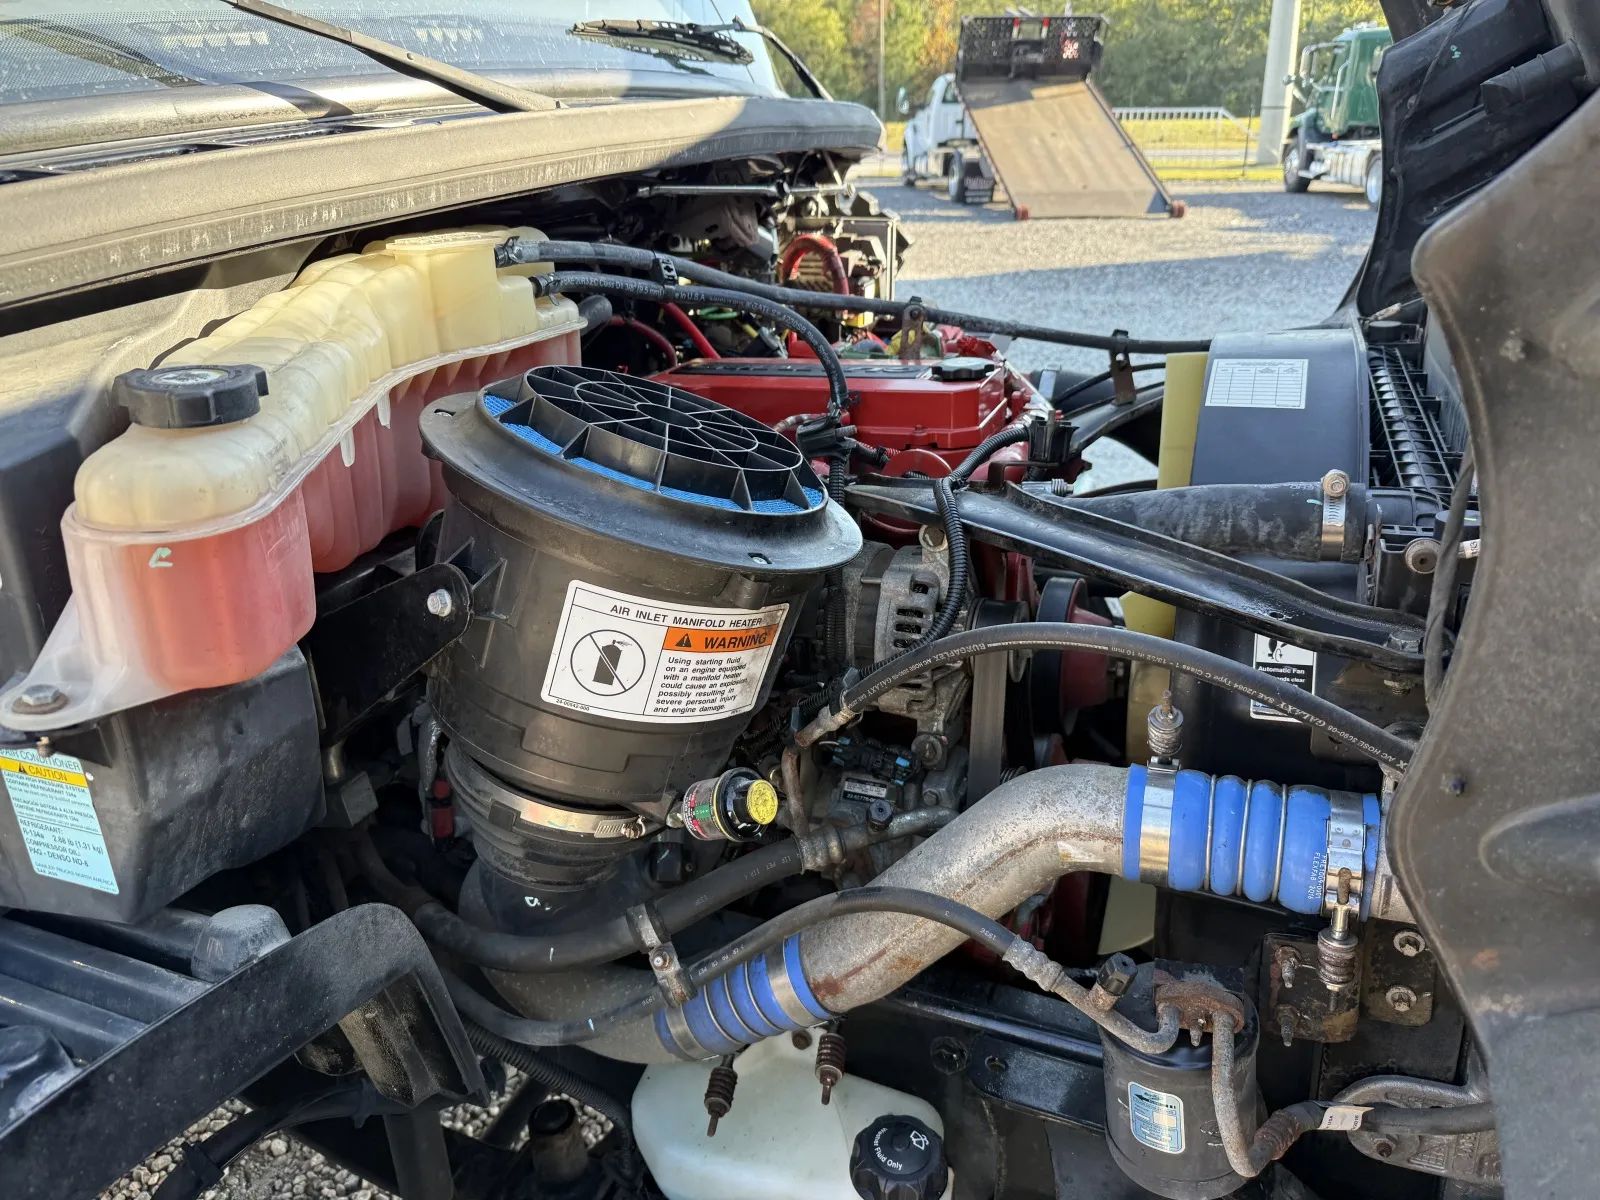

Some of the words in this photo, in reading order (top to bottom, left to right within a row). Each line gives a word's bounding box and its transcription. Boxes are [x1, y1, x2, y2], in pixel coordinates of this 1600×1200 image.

[610, 604, 630, 616] AIR
[635, 610, 668, 623] INLET
[672, 616, 726, 628] MANIFOLD
[729, 617, 762, 628] HEATER
[704, 632, 768, 649] WARNING
[668, 656, 691, 666] Using
[695, 657, 723, 666] starting
[726, 656, 741, 664] fluid
[665, 665, 676, 673] on
[691, 667, 715, 675] engine
[718, 663, 747, 673] equipped
[722, 672, 742, 680] heater
[1182, 664, 1204, 677] Class
[1204, 671, 1212, 679] C
[1258, 665, 1292, 674] Automatic
[867, 676, 892, 697] GALAXY
[1213, 673, 1233, 687] Type
[658, 690, 692, 698] possibly
[695, 689, 725, 698] resulting
[685, 697, 717, 707] personal
[719, 694, 737, 703] injury
[1258, 691, 1275, 705] SAE
[671, 707, 696, 715] engine
[698, 704, 726, 713] damage.
[1277, 701, 1327, 728] GALAXY
[1356, 740, 1381, 756] HOSE
[20, 750, 81, 772] CONDITIONER
[1379, 750, 1397, 763] A/C
[28, 765, 68, 782] CAUTION
[1310, 851, 1321, 881] FLEXFAB
[873, 1127, 888, 1146] Washer
[874, 1146, 888, 1163] Fluid
[886, 1159, 903, 1171] Only
